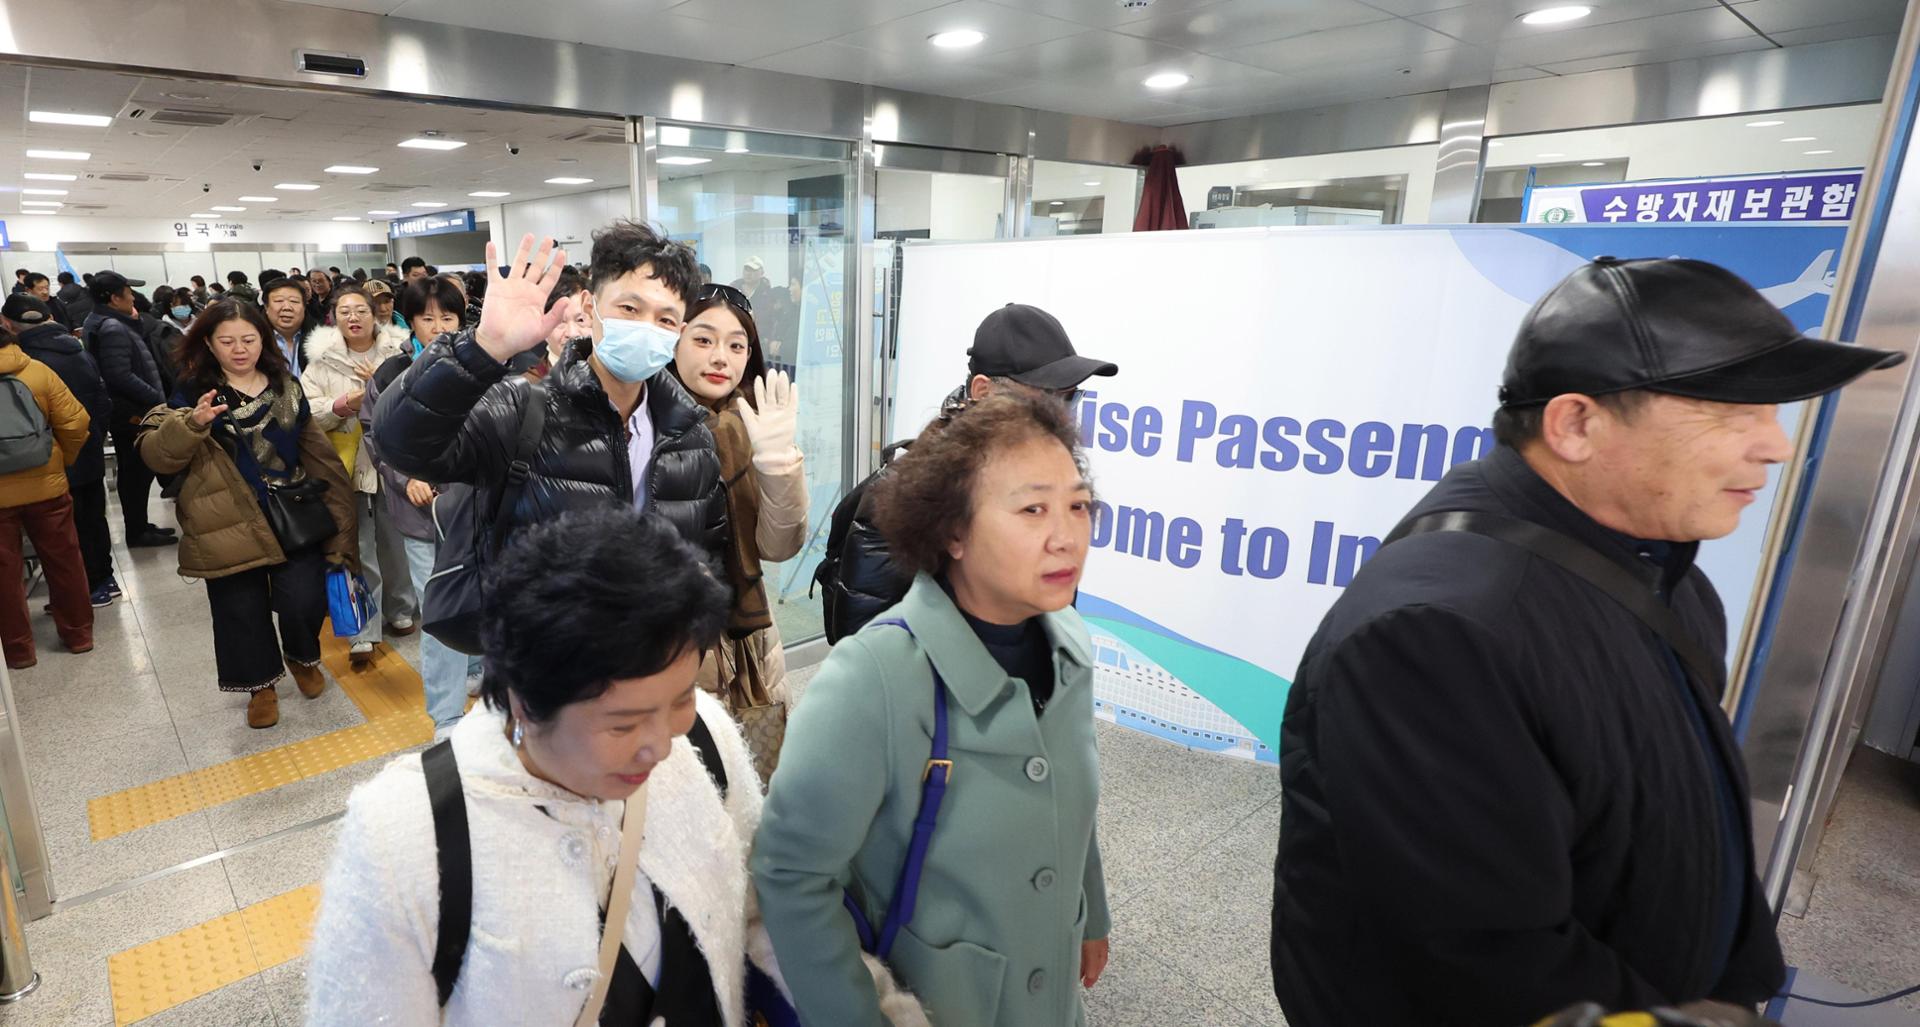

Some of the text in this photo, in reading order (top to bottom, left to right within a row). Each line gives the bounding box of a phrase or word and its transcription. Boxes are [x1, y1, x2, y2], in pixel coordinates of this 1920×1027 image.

[1602, 183, 1857, 223] 수방자재보관함
[1075, 391, 1164, 458] ise
[1220, 517, 1290, 581] to
